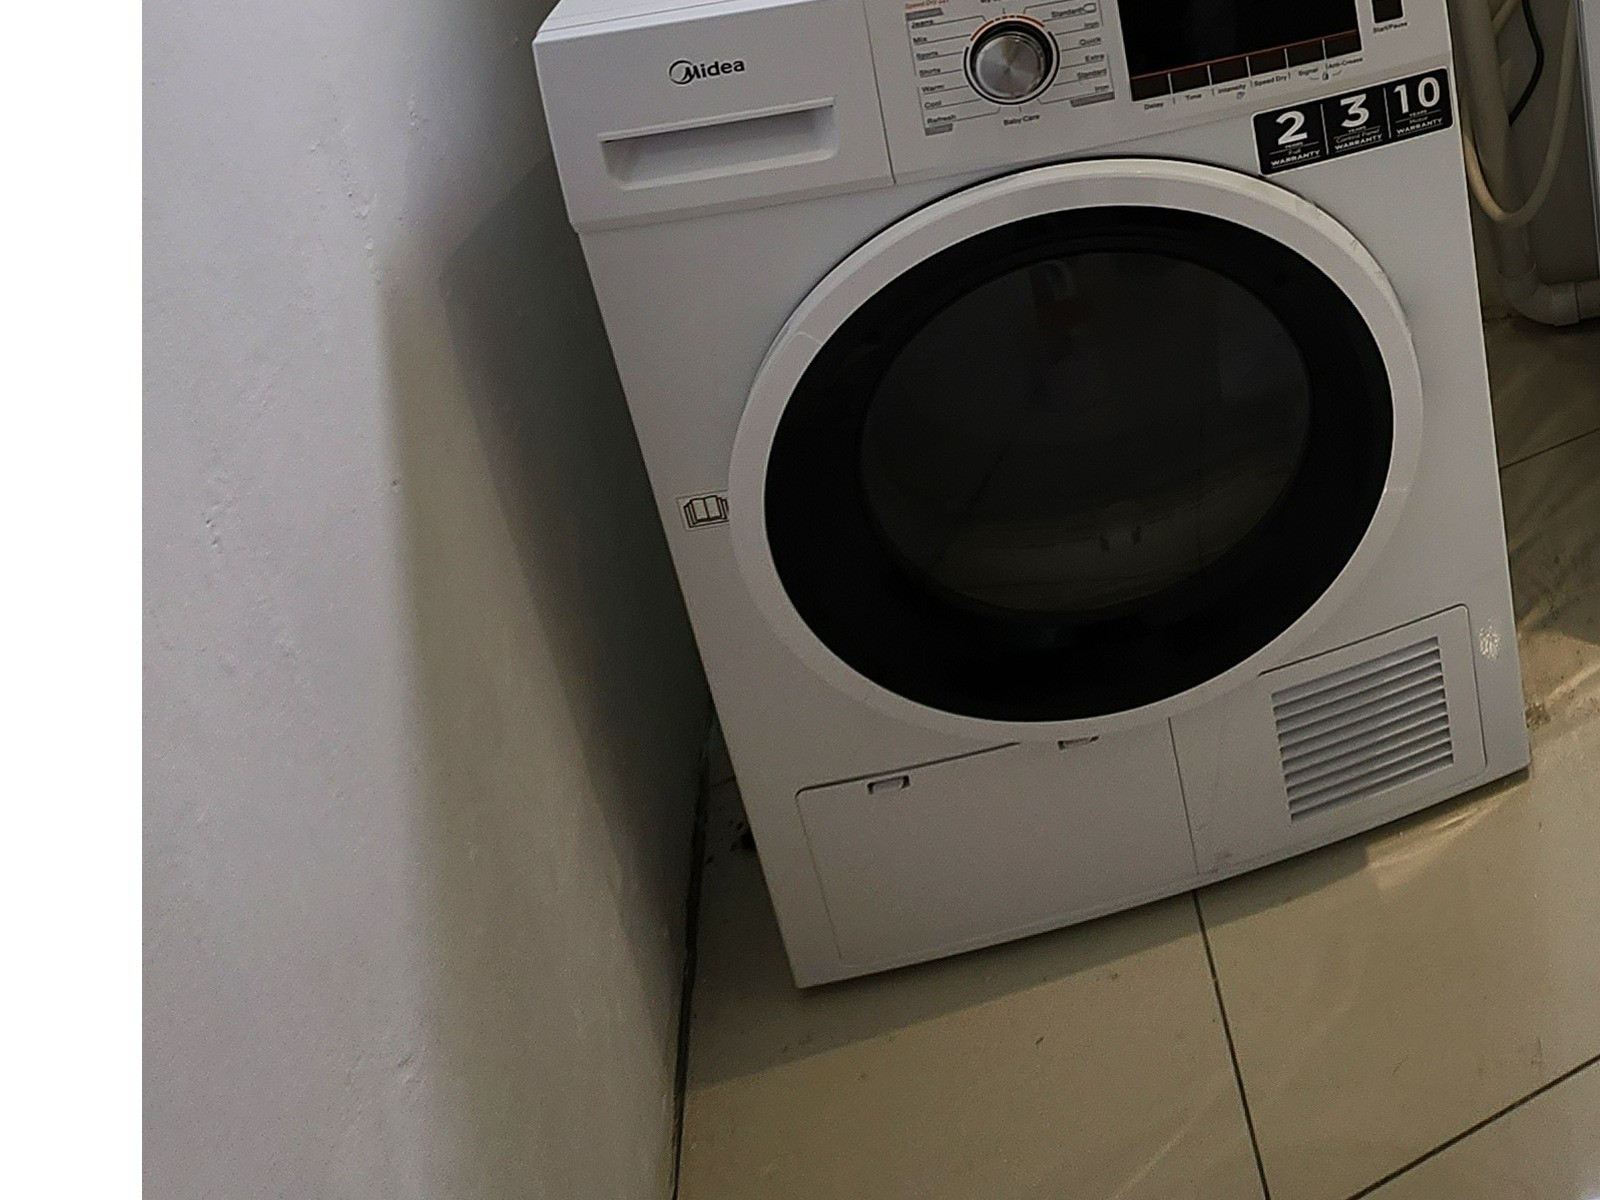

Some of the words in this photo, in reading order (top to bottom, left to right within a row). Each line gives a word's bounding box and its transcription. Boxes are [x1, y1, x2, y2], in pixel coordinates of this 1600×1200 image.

[911, 19, 934, 29] Jeans
[1373, 21, 1408, 34] Start/Pause
[913, 36, 928, 44] Mix
[1079, 37, 1102, 46] Quick
[1085, 54, 1105, 62] Extra
[669, 60, 745, 84] Midea
[1254, 77, 1275, 88] Speed
[1275, 74, 1288, 84] Dry
[922, 84, 945, 92] Warm
[1393, 77, 1441, 114] 10
[924, 100, 942, 109] Cool
[1340, 93, 1370, 128] 3
[927, 114, 956, 124] Refresh
[1003, 117, 1022, 126] Baby
[1022, 113, 1040, 122] Care
[1275, 110, 1308, 146] 2
[1396, 117, 1444, 135] WARRANTY
[1334, 134, 1383, 151] WARRANTY
[1270, 149, 1321, 167] WARRANTY
